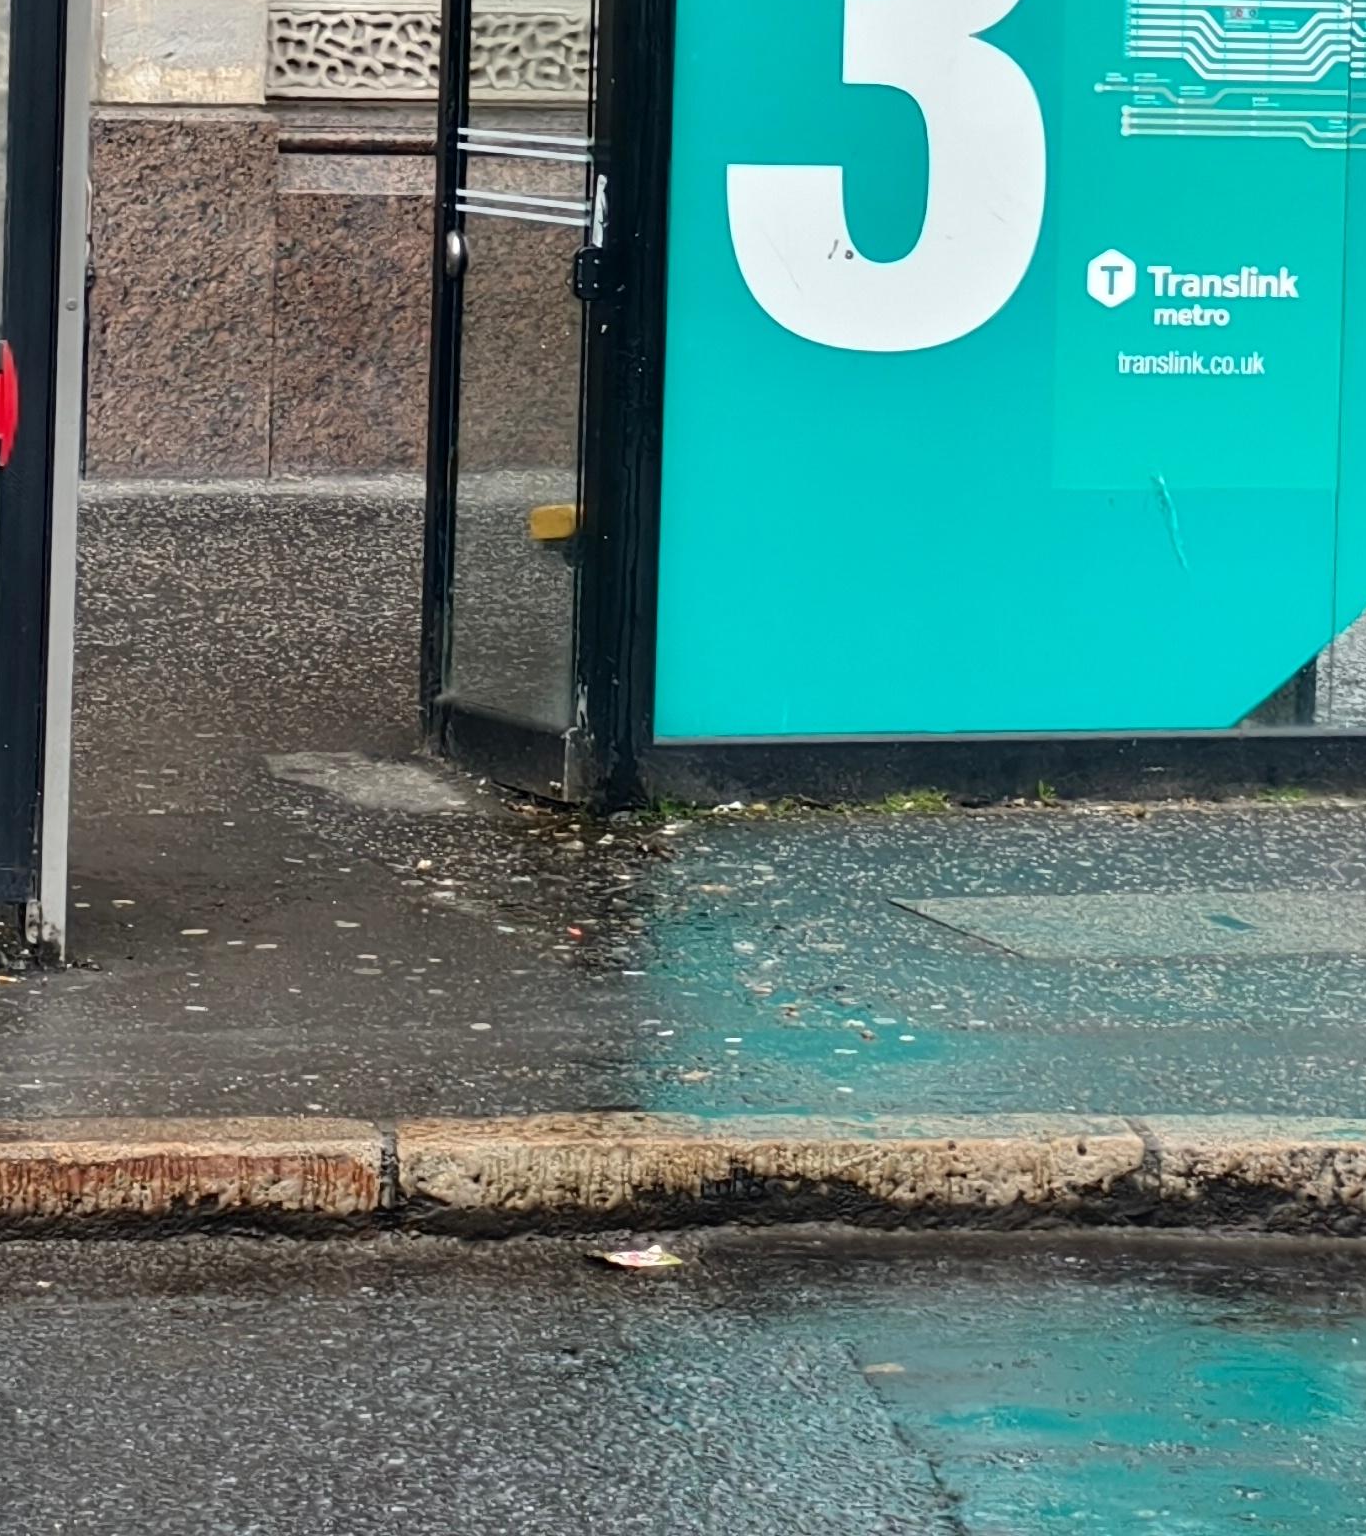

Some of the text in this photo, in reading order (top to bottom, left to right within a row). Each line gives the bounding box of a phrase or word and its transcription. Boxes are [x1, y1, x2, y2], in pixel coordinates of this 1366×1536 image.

[1146, 265, 1299, 298] Translink
[1153, 303, 1231, 326] metro
[1117, 350, 1266, 375] translink.co.uk
